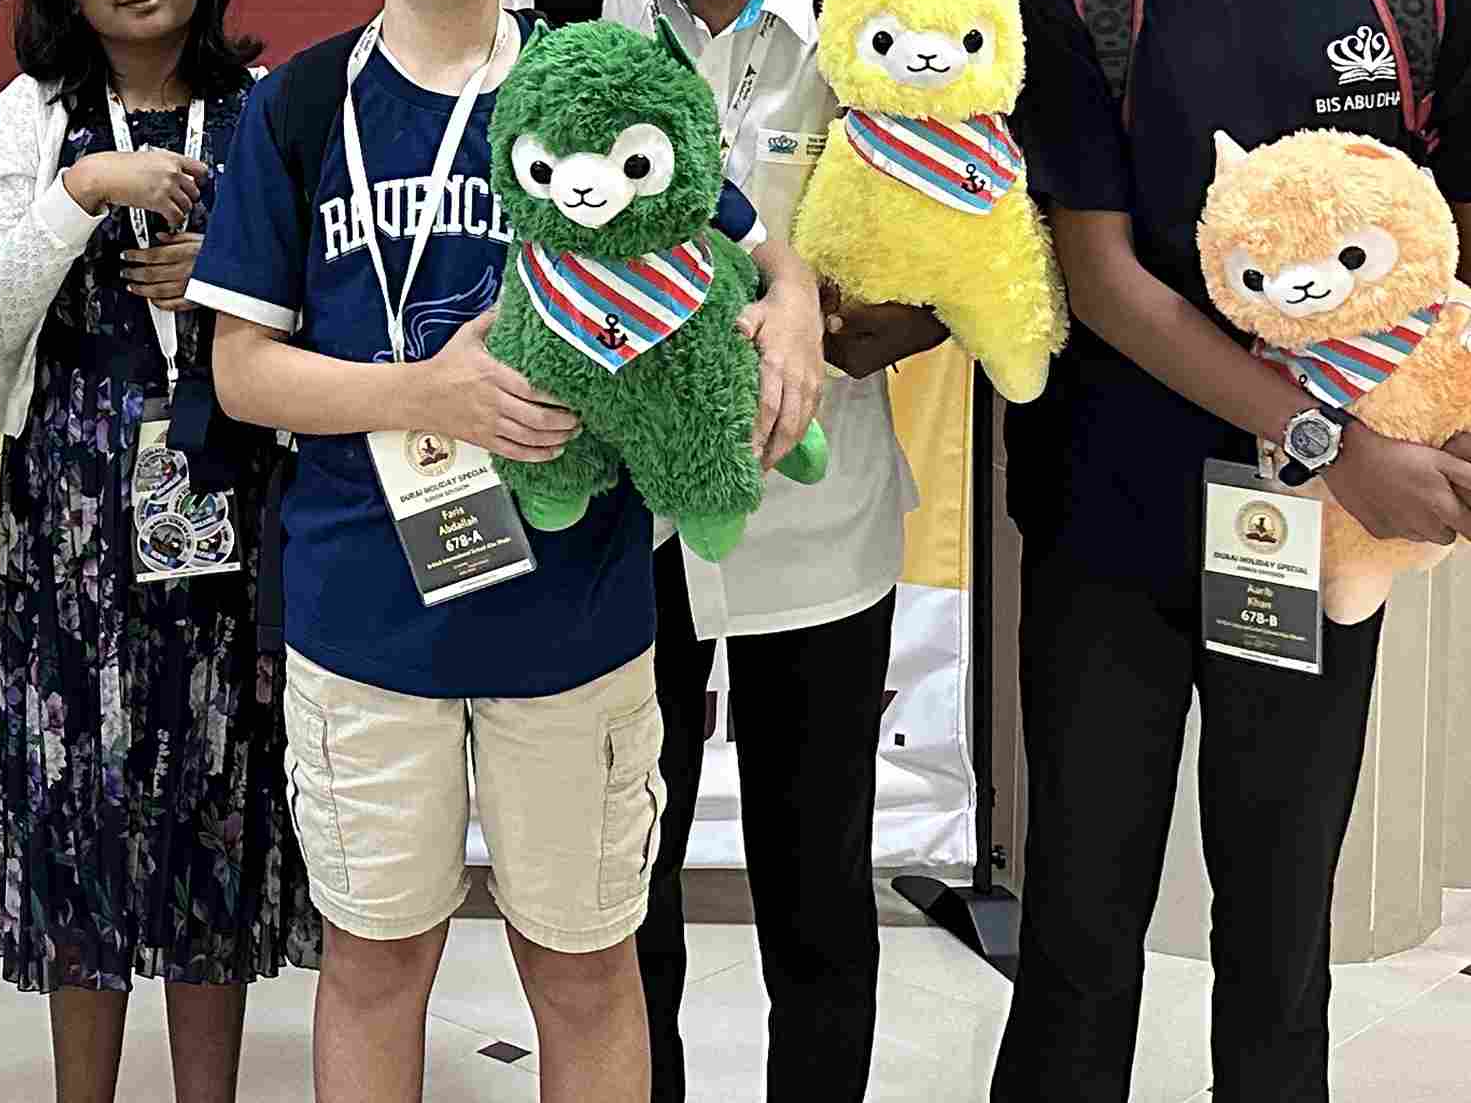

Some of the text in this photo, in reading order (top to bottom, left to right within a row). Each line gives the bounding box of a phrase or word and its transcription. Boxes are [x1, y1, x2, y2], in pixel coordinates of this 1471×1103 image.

[1315, 91, 1401, 114] BIS ABU DHA
[319, 174, 514, 261] RAVENCL
[445, 529, 484, 552] 678-A
[1240, 609, 1279, 627] 678-B
